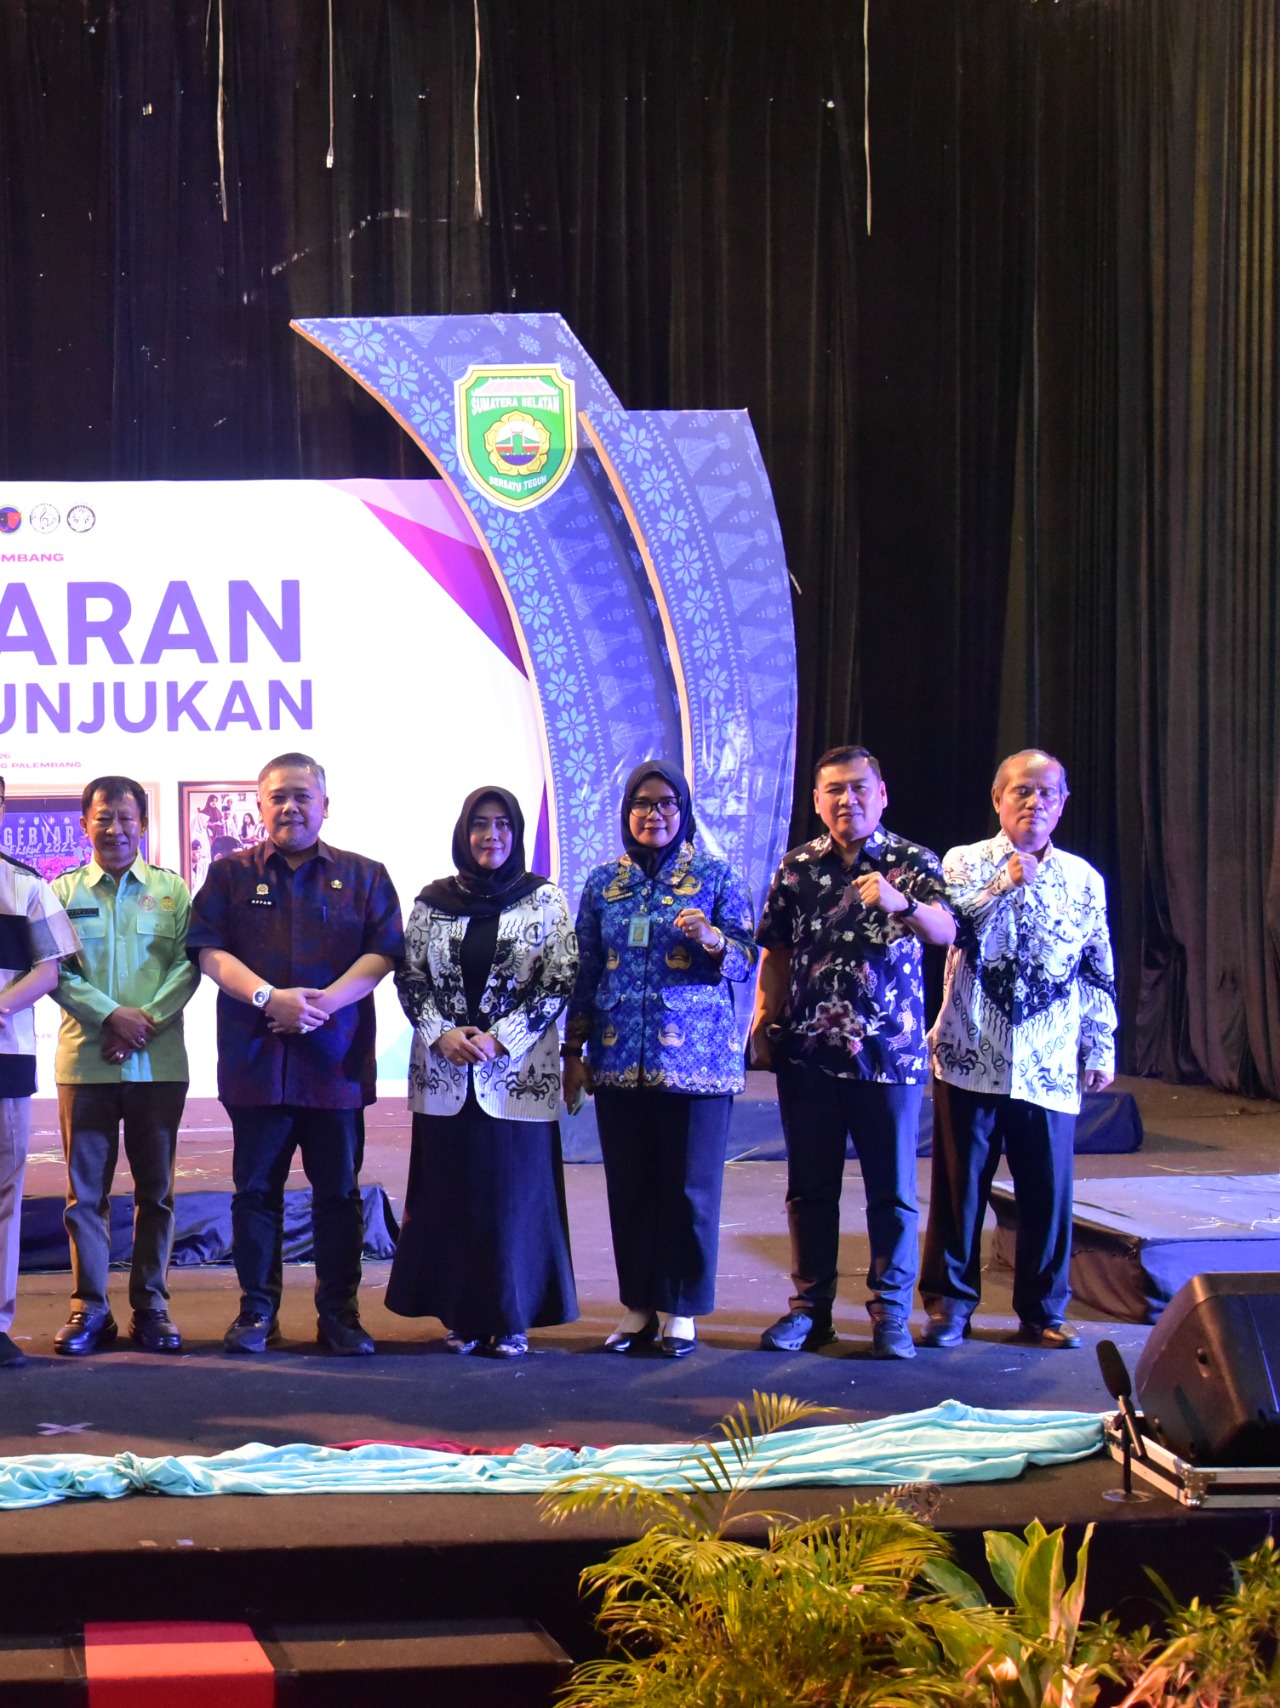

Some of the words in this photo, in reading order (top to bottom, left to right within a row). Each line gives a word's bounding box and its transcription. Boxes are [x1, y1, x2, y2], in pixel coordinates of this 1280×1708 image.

[471, 396, 518, 416] SUMATERA
[521, 395, 560, 414] SELATAN
[488, 475, 522, 493] BERSATU
[524, 474, 547, 491] TEGUH
[11, 761, 83, 769] PALEMBANG
[3, 825, 74, 847] GEBYAR
[44, 841, 77, 853] 2025
